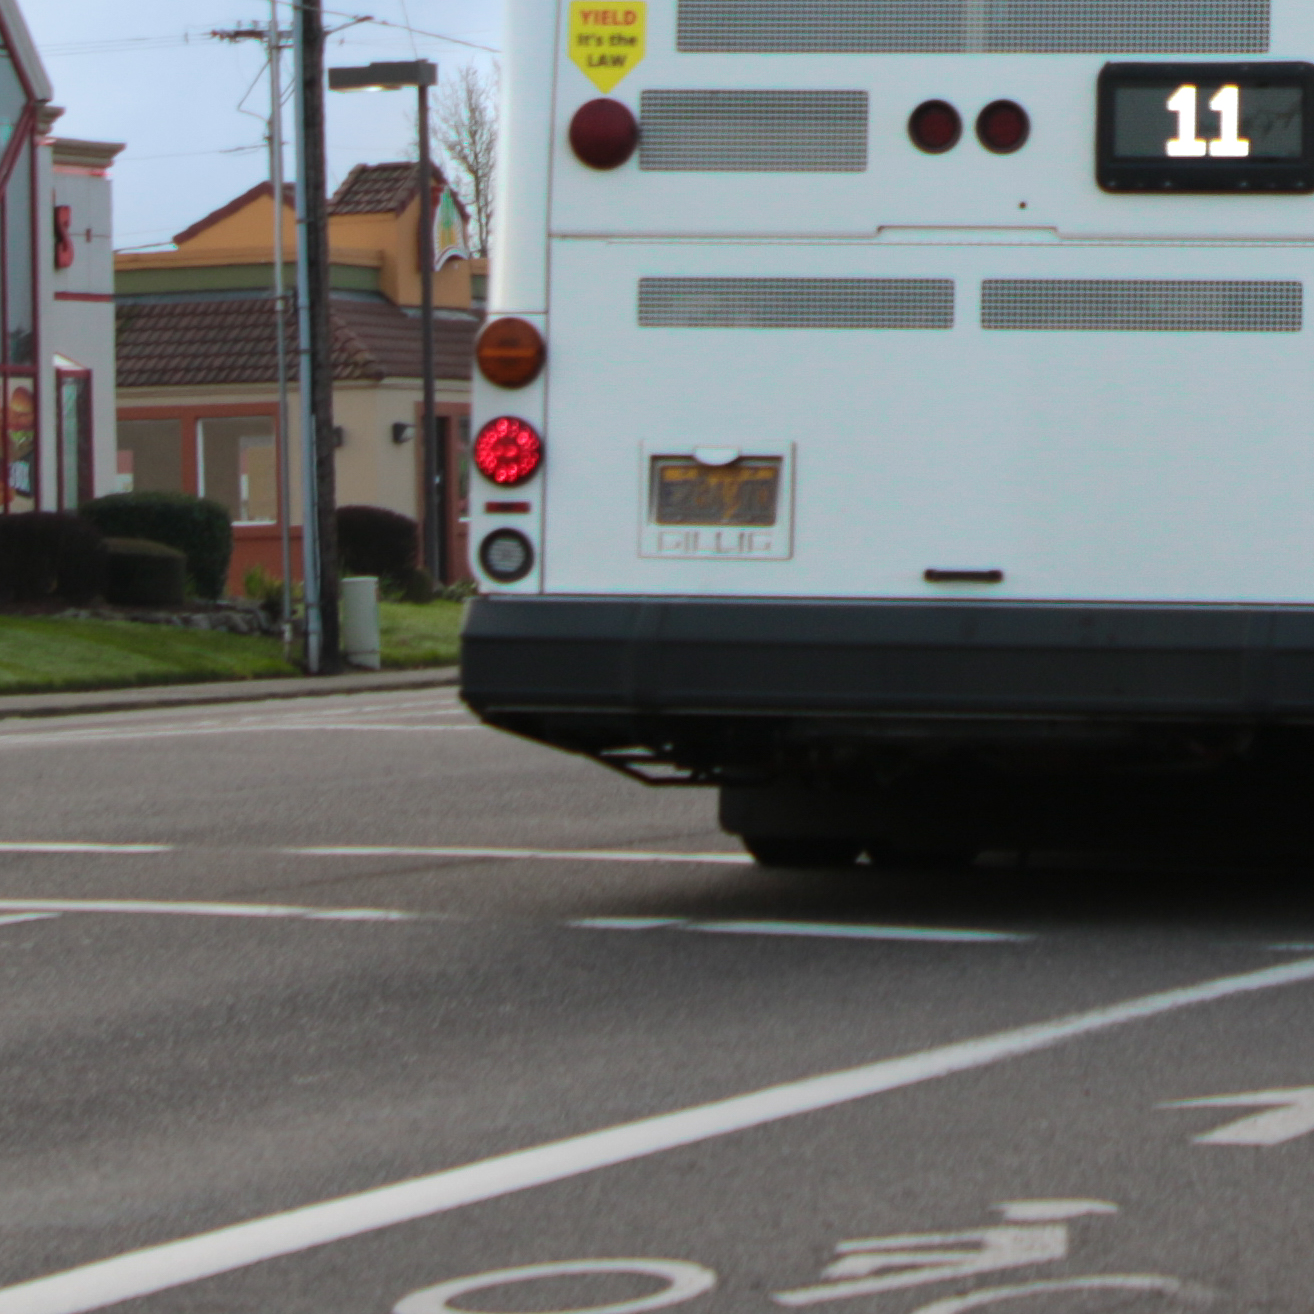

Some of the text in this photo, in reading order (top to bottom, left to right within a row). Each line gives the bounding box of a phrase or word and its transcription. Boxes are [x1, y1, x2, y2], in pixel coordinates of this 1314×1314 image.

[579, 9, 638, 26] YIELD
[578, 32, 639, 48] It's the
[586, 53, 629, 67] LAW
[1164, 82, 1250, 158] 11
